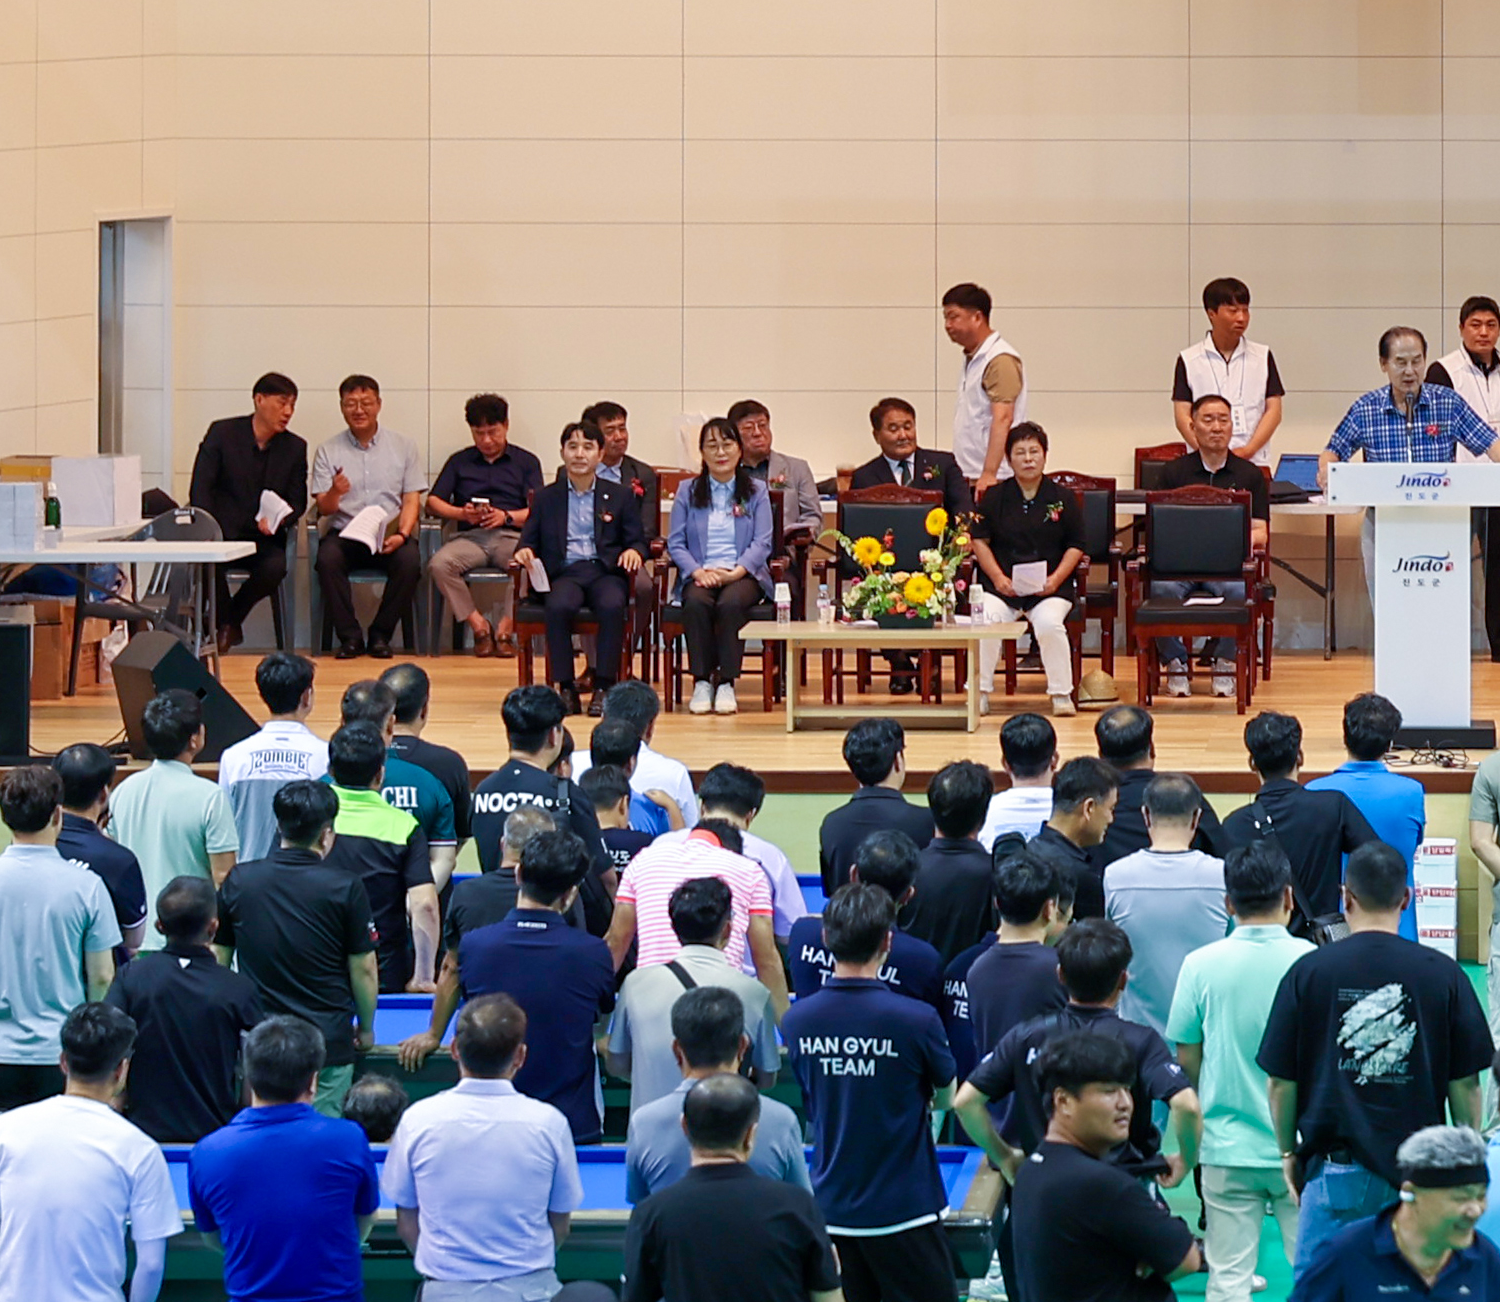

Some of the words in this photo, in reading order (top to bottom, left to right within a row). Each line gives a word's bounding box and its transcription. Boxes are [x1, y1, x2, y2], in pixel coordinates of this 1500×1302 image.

[1396, 470, 1442, 488] Jindo
[1405, 492, 1439, 500] 진도군
[1392, 556, 1443, 573] Jindo
[1402, 578, 1441, 587] 진도군
[254, 751, 306, 769] ZOMBIE
[380, 786, 419, 809] CHI
[876, 963, 901, 985] UL
[953, 999, 970, 1020] TE
[799, 1036, 840, 1056] HAN
[843, 1036, 900, 1058] GYUL
[818, 1056, 876, 1077] TEAM
